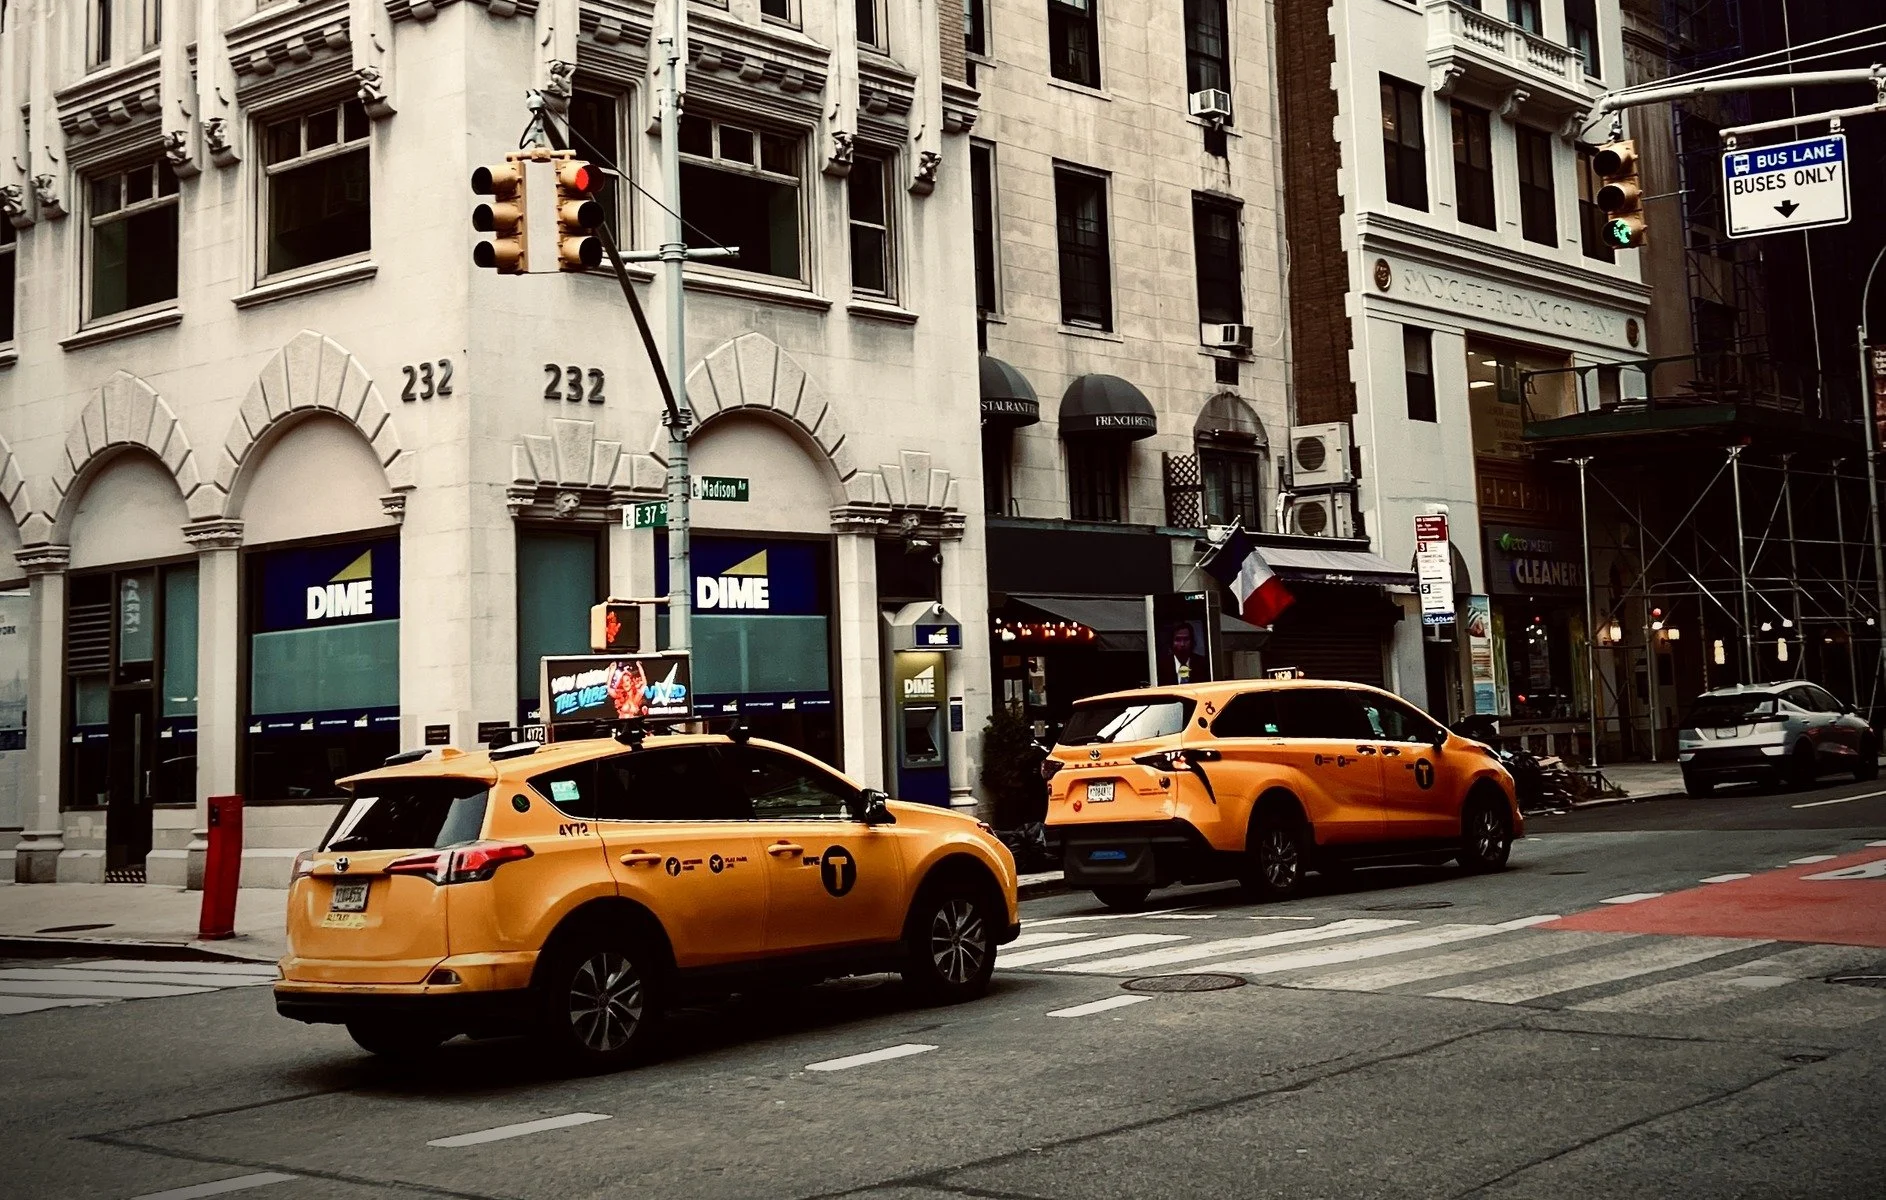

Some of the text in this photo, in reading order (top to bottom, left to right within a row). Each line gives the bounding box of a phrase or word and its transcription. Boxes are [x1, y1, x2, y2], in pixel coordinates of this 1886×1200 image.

[1756, 144, 1836, 168] BUS LANE
[1733, 165, 1837, 196] BUSES ONLY
[401, 358, 453, 402] 232
[544, 363, 605, 404] 232
[1095, 415, 1134, 427] FRENCH
[702, 480, 736, 498] Madison
[635, 507, 642, 526] E
[644, 506, 657, 524] 37
[307, 580, 373, 620] DIME
[696, 576, 769, 609] DIME
[1422, 585, 1430, 594] 5
[928, 634, 949, 645] DIME
[904, 678, 935, 694] DIME
[554, 684, 608, 714] THE VIBE
[527, 727, 544, 741] 4Y72
[828, 856, 848, 890] T
